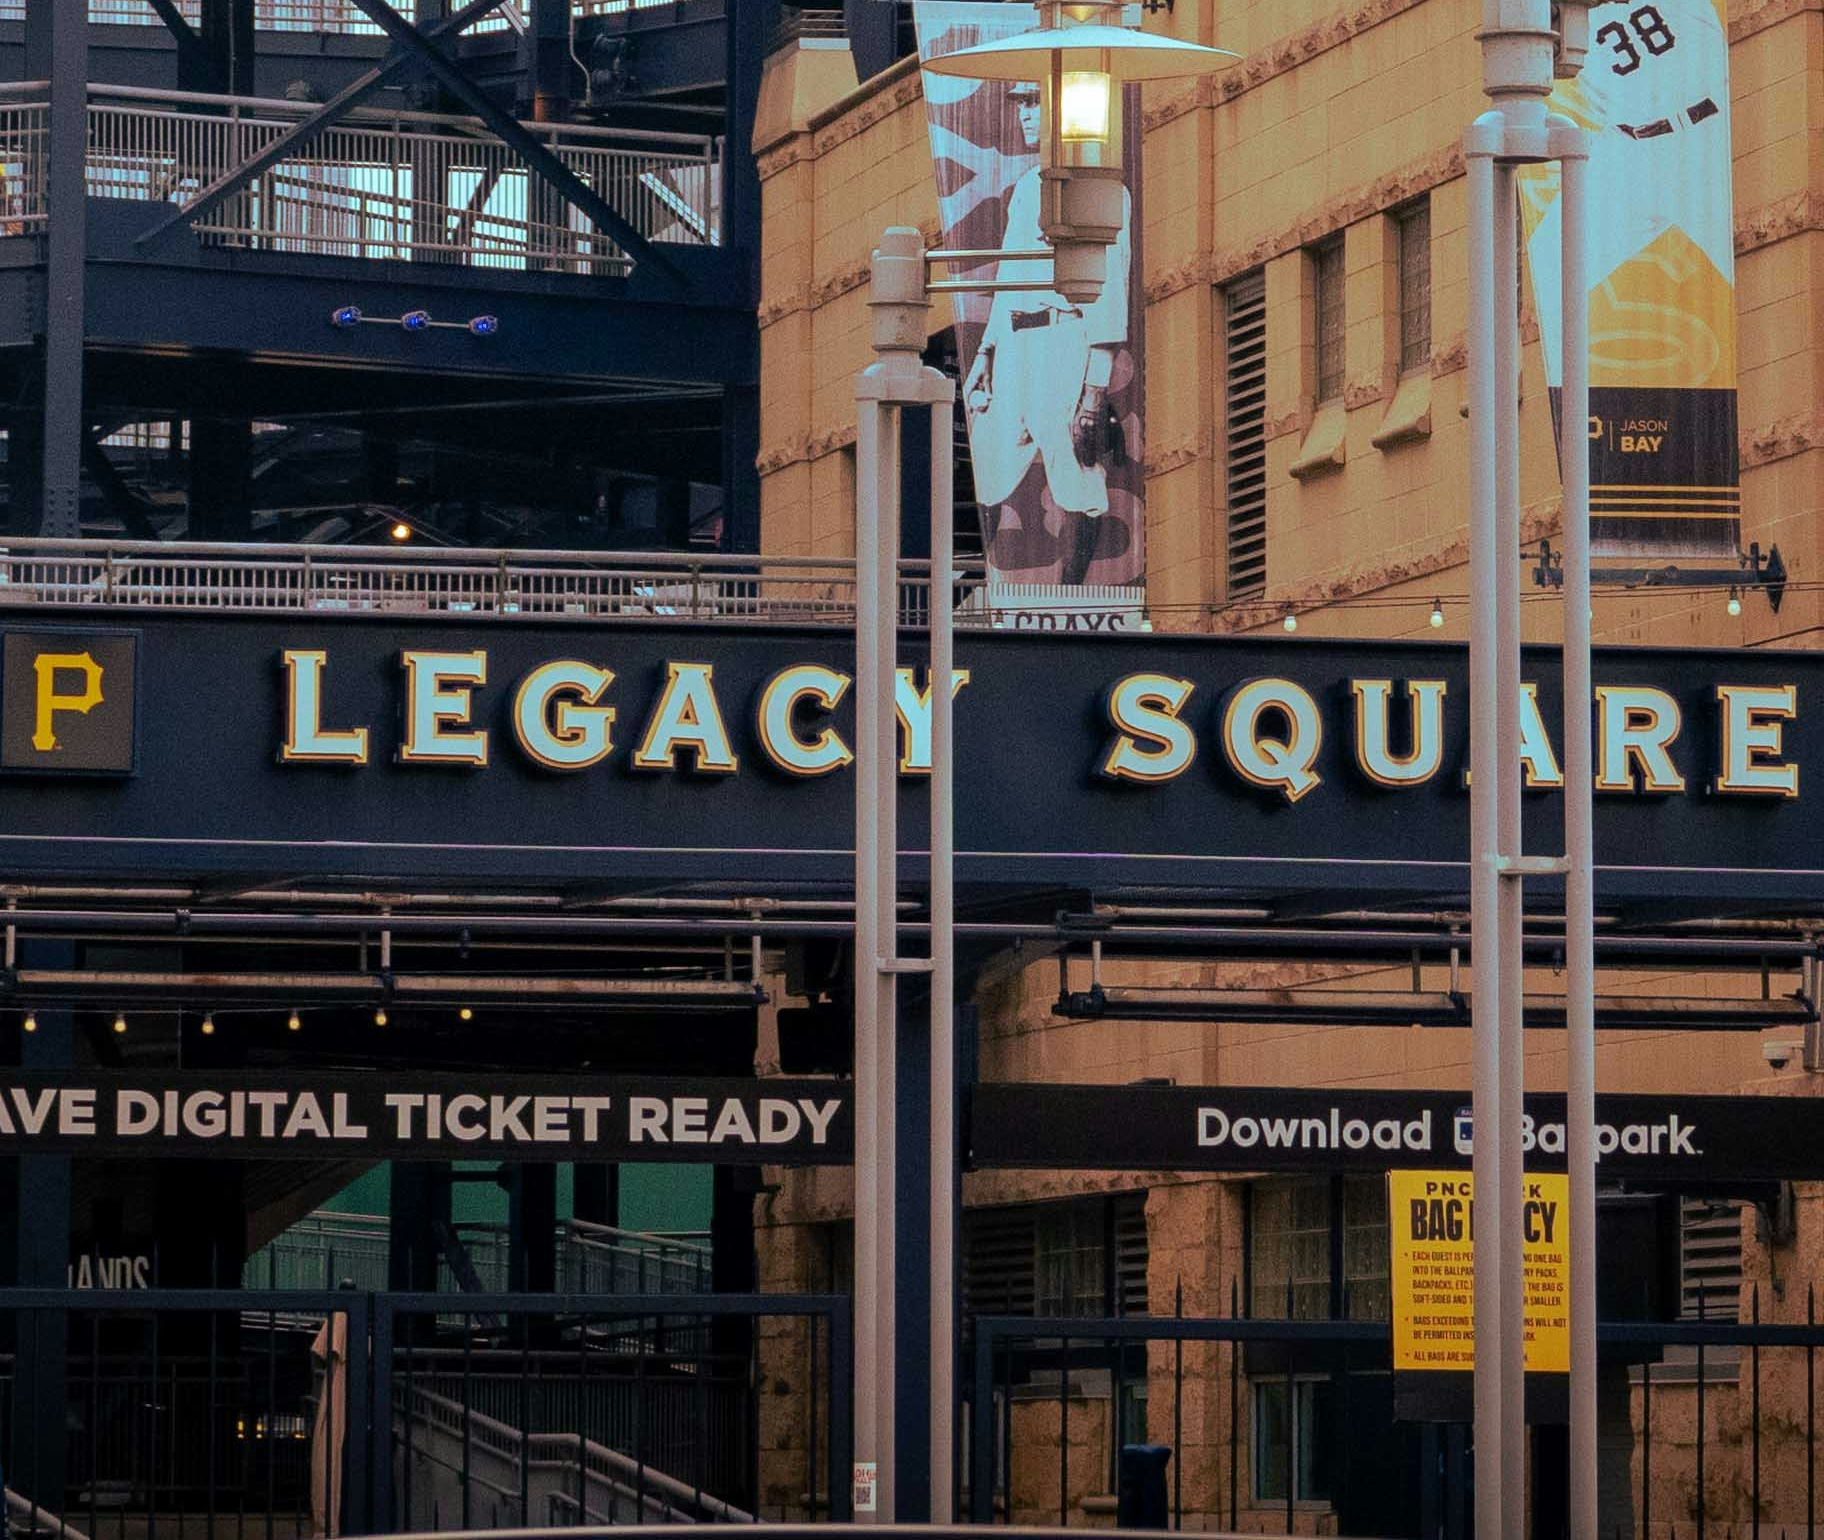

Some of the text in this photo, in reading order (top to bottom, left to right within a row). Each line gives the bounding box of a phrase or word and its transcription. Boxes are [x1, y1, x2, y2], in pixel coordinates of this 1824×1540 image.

[1596, 5, 1676, 76] 38
[1620, 419, 1668, 432] JASON
[1620, 437, 1663, 453] BAY
[32, 652, 105, 751] P
[280, 648, 971, 774] LEGACY
[117, 1090, 367, 1140] DIGITAL
[385, 1094, 610, 1142] TICKET
[629, 1097, 841, 1145] READY
[1197, 1108, 1431, 1152] Download
[1426, 1182, 1471, 1195] PNC
[1411, 1199, 1463, 1241] BAG
[1412, 1251, 1430, 1261] EACH
[1431, 1252, 1453, 1262] GUEST
[1412, 1266, 1429, 1275] INTO
[1430, 1266, 1442, 1275] THE
[1444, 1267, 1474, 1277] BALLPAR
[1453, 1295, 1467, 1305] AND
[1413, 1316, 1430, 1326] BAGS
[1413, 1331, 1421, 1340] BE
[1414, 1351, 1426, 1361] ALL
[1446, 1352, 1460, 1362] ARE
